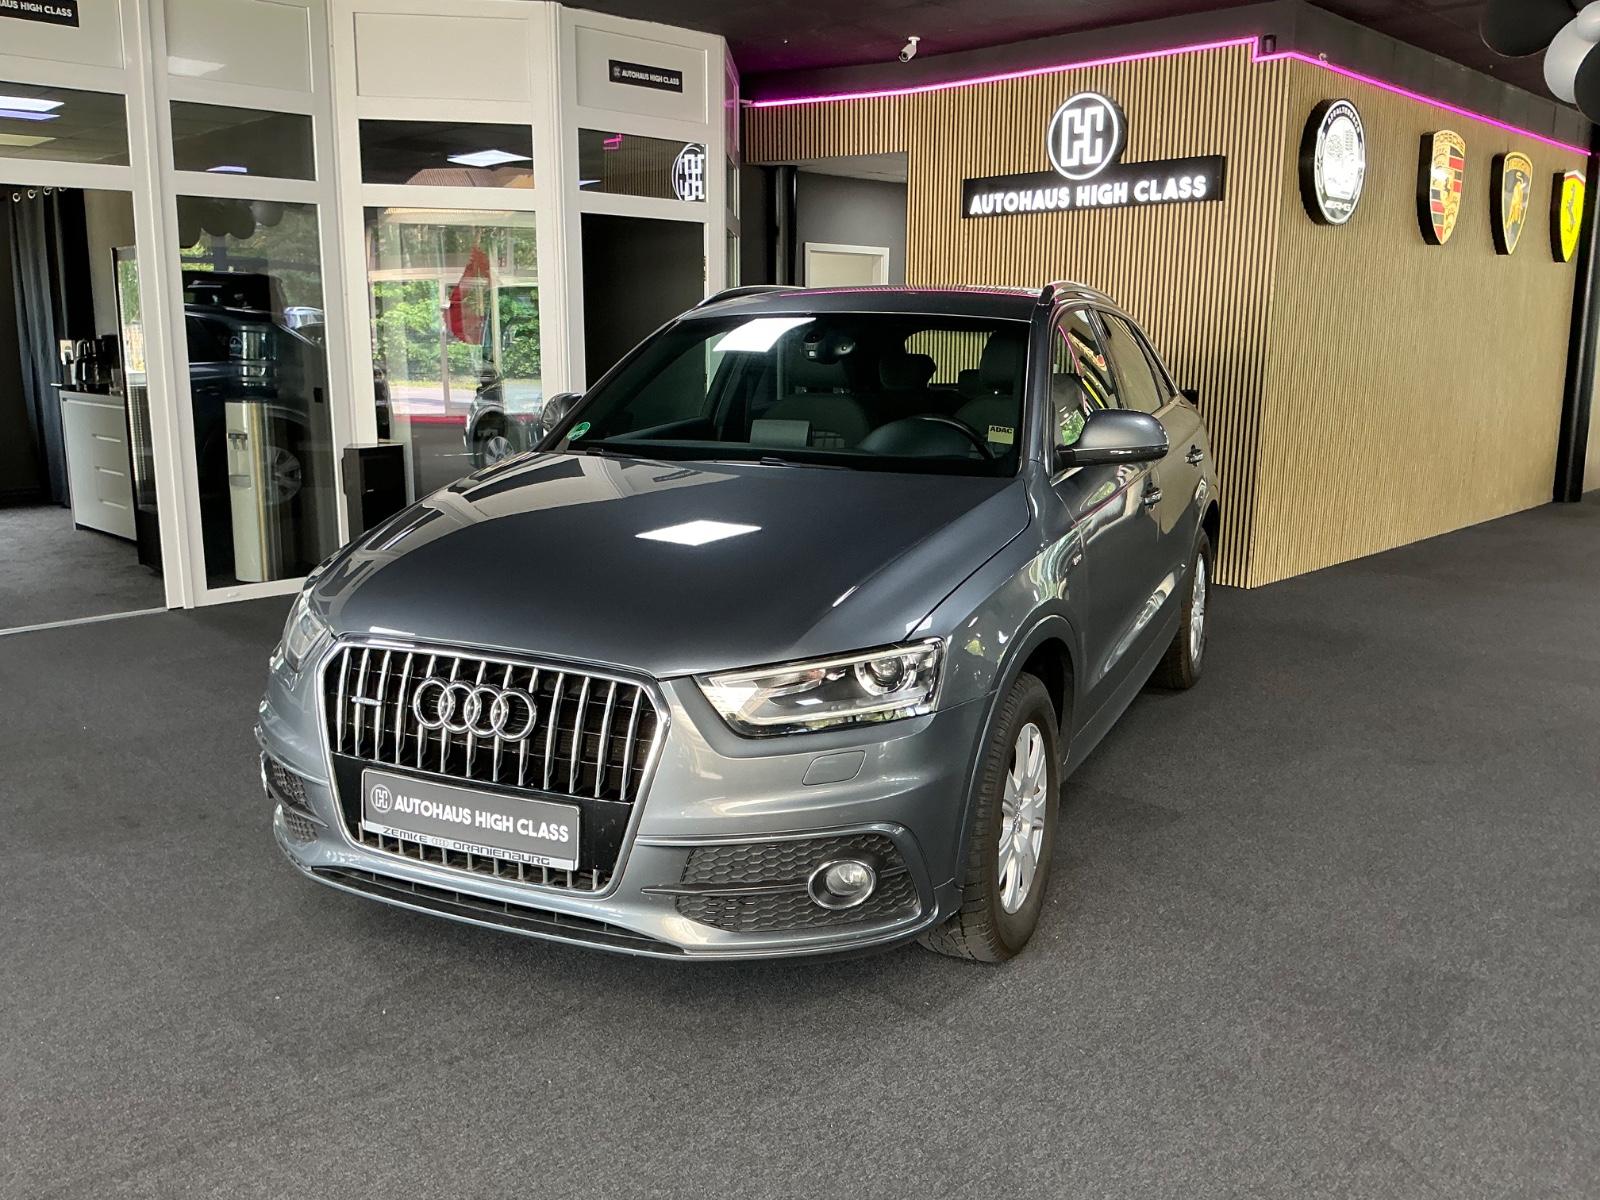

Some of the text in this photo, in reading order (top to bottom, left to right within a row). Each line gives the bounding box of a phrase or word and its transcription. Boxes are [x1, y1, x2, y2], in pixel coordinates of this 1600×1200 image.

[20, 2, 43, 13] HIGH
[44, 5, 73, 17] CLASS
[622, 69, 649, 81] AUTOHAUS
[649, 74, 663, 83] HIGH
[663, 76, 680, 86] CLASS
[969, 176, 1206, 214] AUTOHAUS HIGH CLASS
[990, 426, 1013, 434] ADAC
[394, 794, 472, 825] AUTOHAUS
[475, 810, 514, 833] HIGH
[516, 818, 569, 843] CLASS
[383, 826, 550, 866] ZEMKE ORANIENBURG
